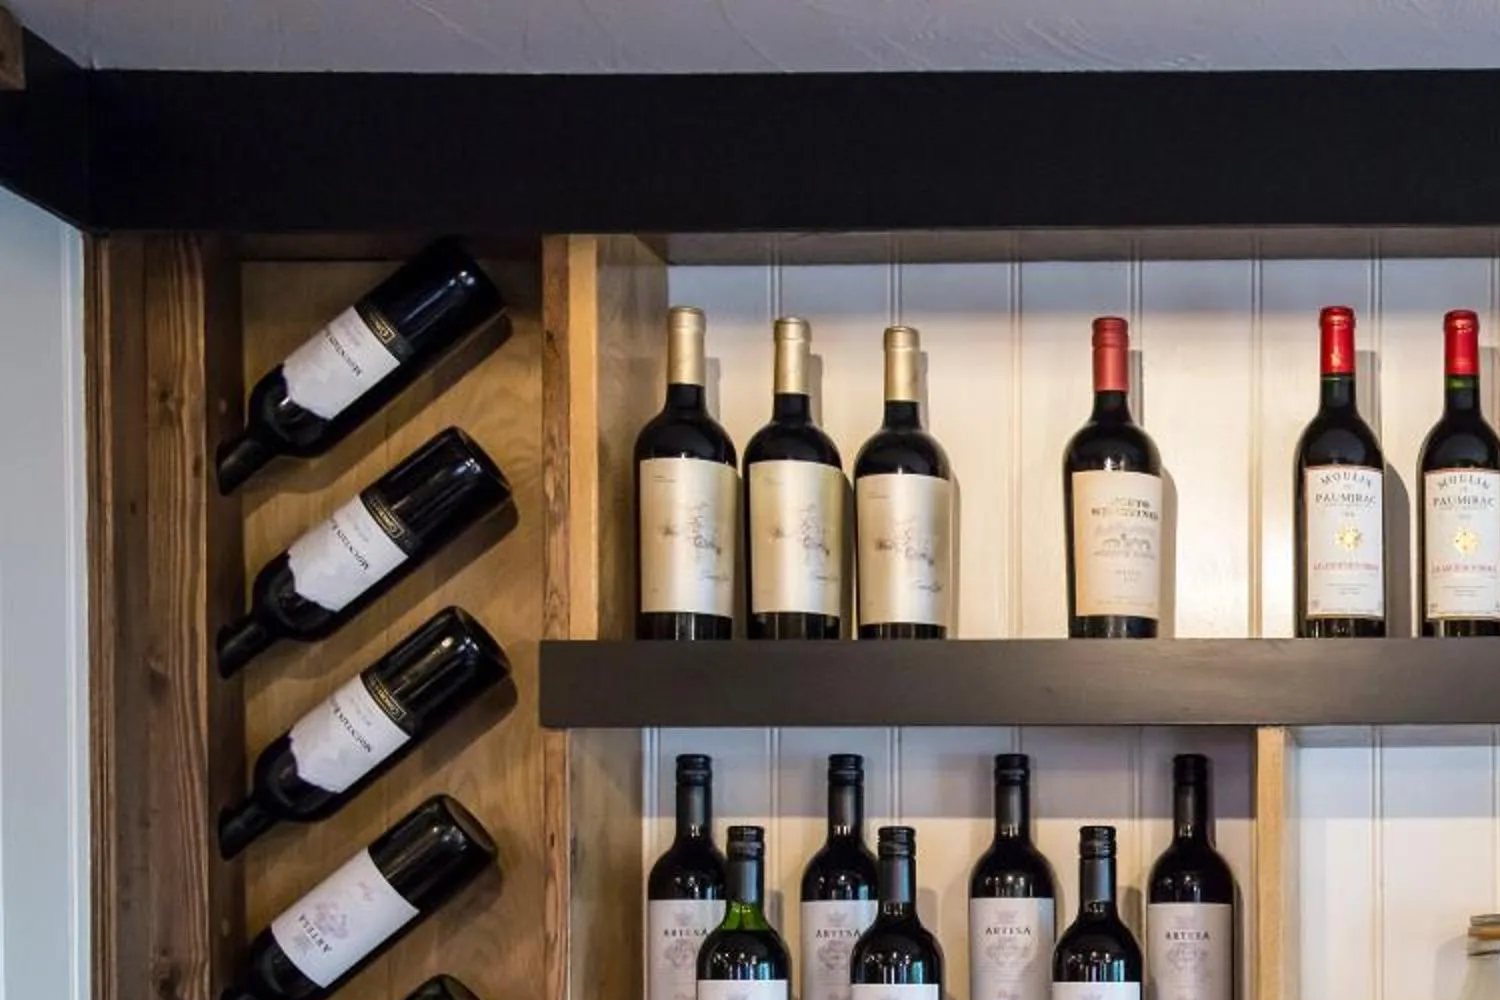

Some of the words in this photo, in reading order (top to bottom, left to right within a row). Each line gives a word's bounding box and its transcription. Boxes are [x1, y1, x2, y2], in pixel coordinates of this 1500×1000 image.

[662, 926, 709, 938] ARTESA
[815, 928, 861, 939] ARTESA
[984, 926, 1032, 936] ARTESA
[1165, 931, 1210, 941] ARTESA
